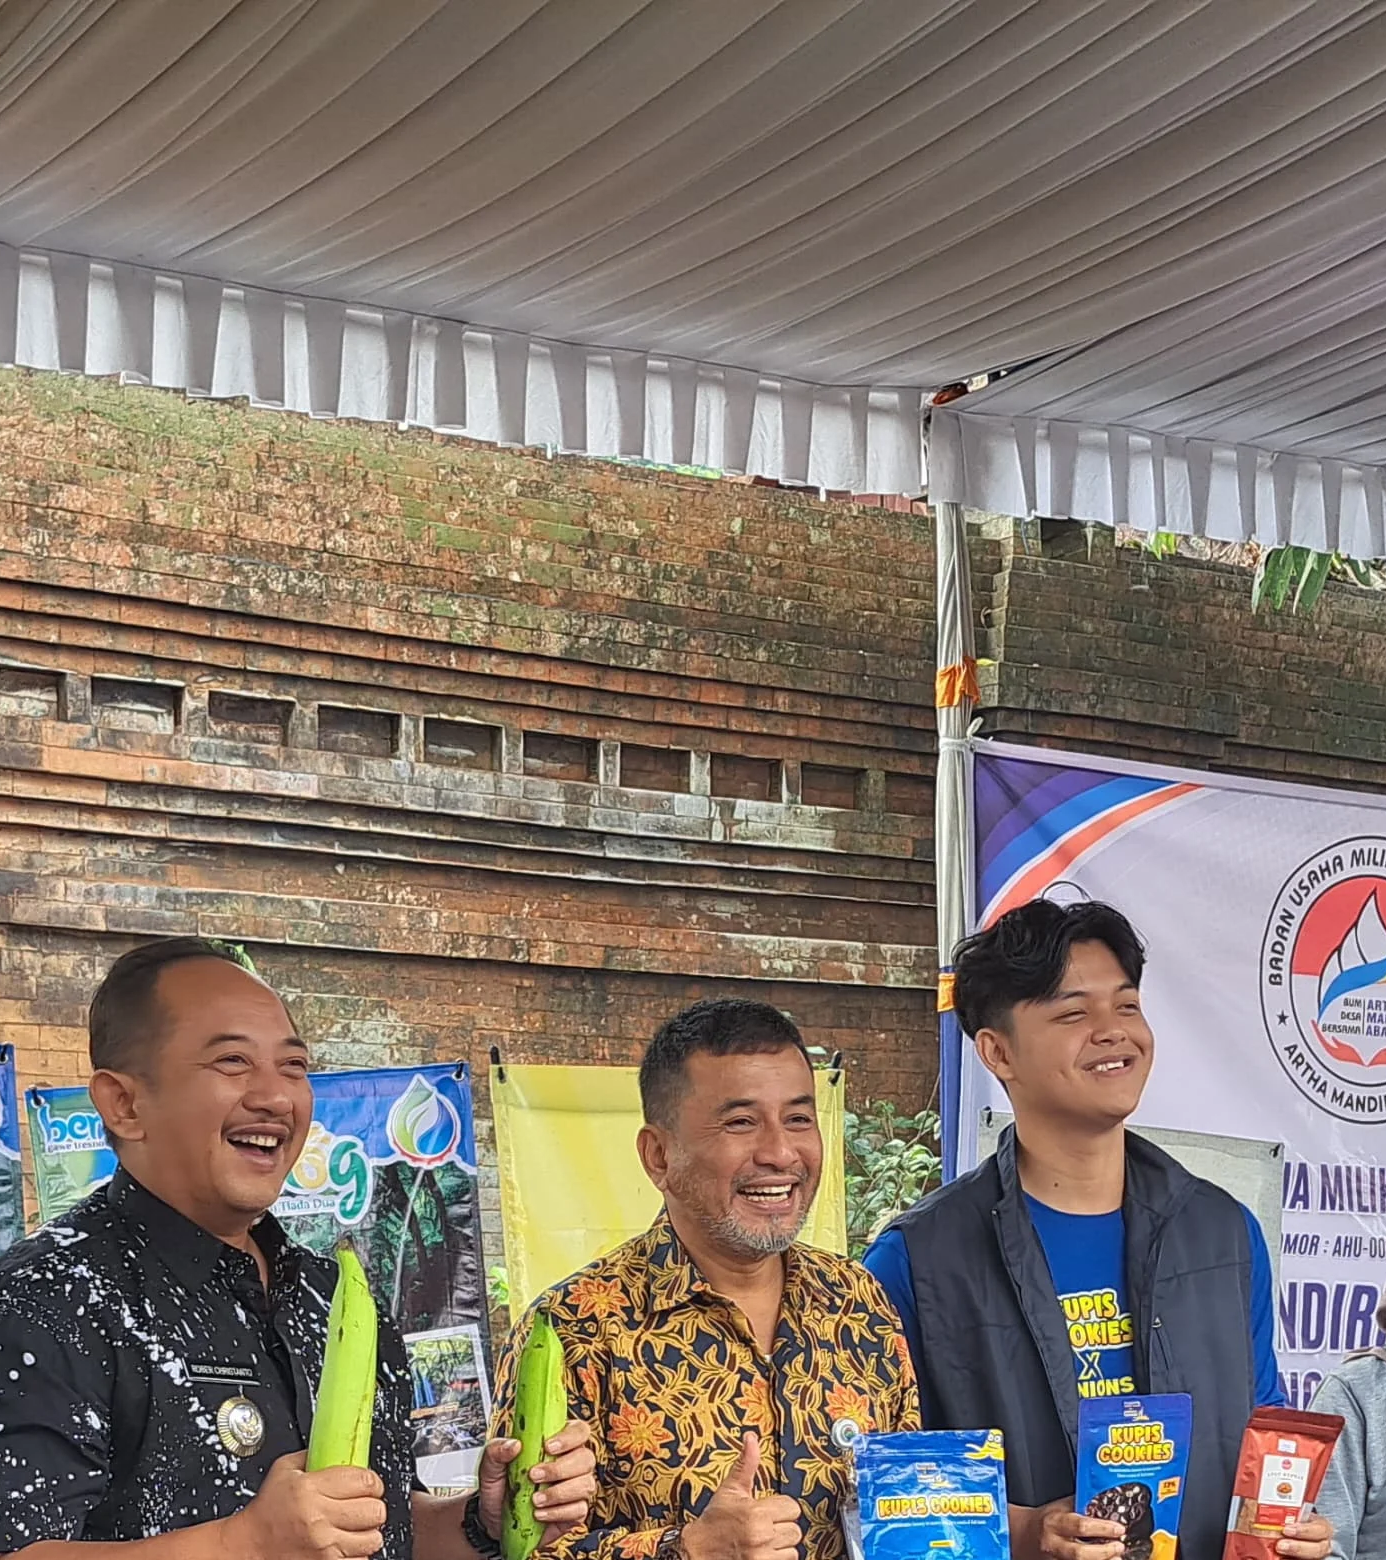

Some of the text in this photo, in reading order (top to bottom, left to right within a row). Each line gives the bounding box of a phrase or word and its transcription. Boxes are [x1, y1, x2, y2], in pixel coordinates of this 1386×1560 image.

[1268, 907, 1296, 986] BADAN
[1289, 854, 1344, 906] USAHA
[1343, 998, 1363, 1008] BUM
[1340, 1011, 1361, 1021] DESA
[1321, 1023, 1361, 1035] BERSAMA
[1283, 1043, 1328, 1100] ARTHA
[1281, 1233, 1321, 1258] MOR
[1060, 1290, 1117, 1321] UPIS
[1067, 1316, 1133, 1348] OKIES
[1077, 1376, 1135, 1399] NIONS
[1109, 1423, 1164, 1446] KUPIS
[1097, 1440, 1174, 1464] COOKIES
[878, 1494, 993, 1518] KUPIS COOKIES
